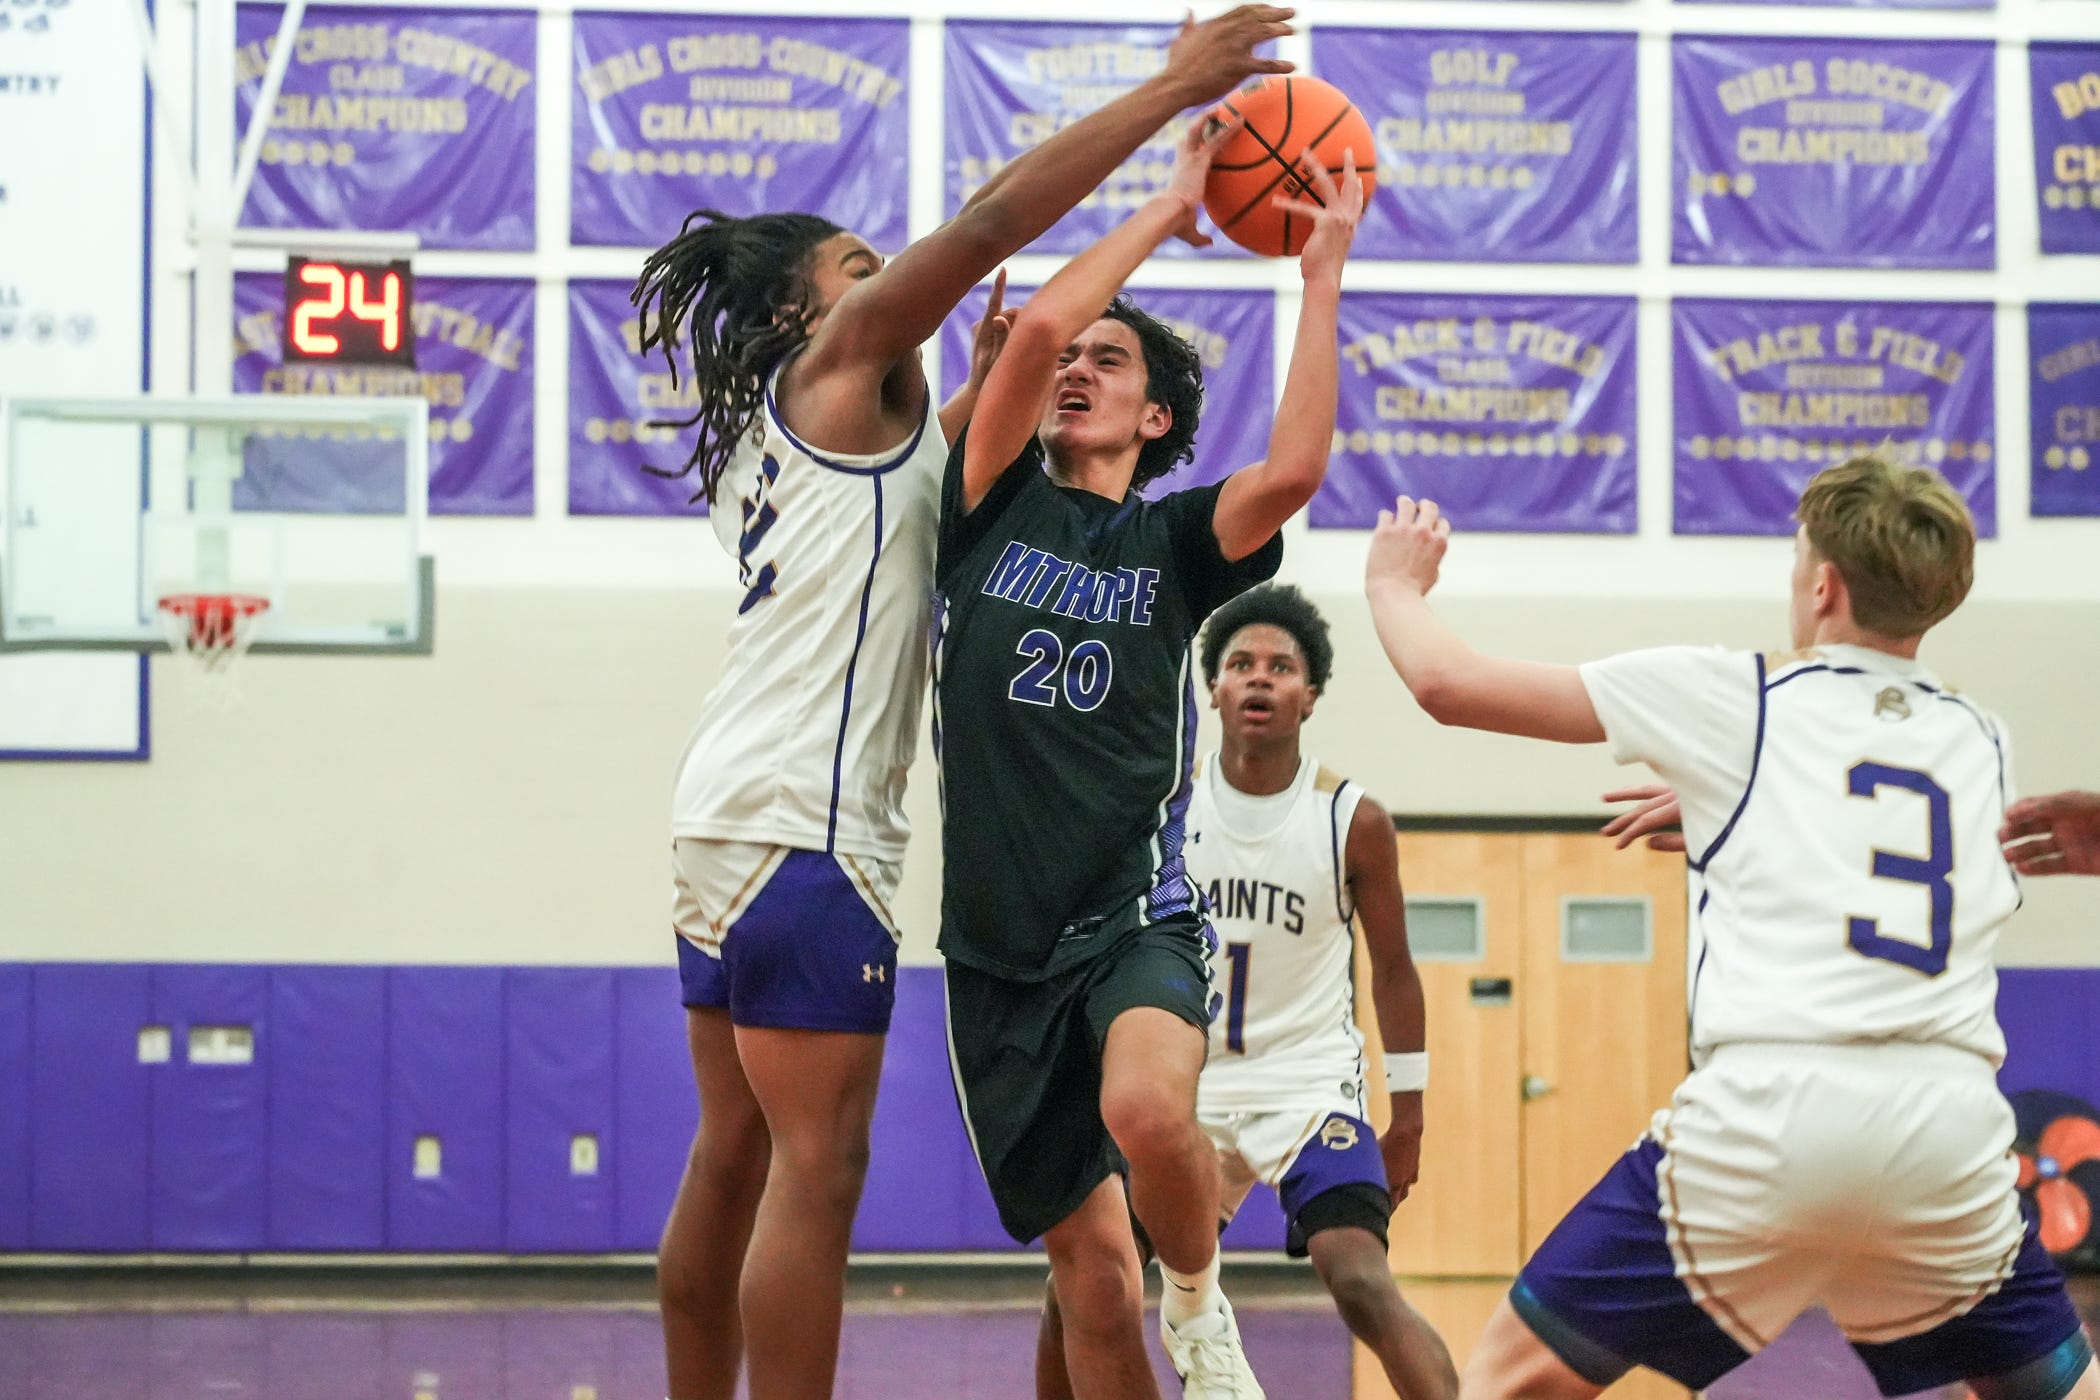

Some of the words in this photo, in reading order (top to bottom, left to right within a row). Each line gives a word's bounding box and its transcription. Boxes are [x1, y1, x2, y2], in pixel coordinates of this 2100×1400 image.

[579, 42, 664, 101] GIRLS
[1430, 49, 1520, 86] GOLF
[1717, 59, 1817, 115] GIRLS
[1826, 58, 1955, 118] SOCCER
[267, 95, 468, 133] CHAMPIONS
[639, 103, 842, 143] CHAMPIONS
[1377, 116, 1573, 155] CHAMPIONS
[1786, 100, 1885, 126] DIVISION
[1738, 127, 1930, 164] CHAMPIONS
[293, 263, 401, 355] 24
[1342, 318, 1461, 377] TRACK
[1507, 319, 1605, 379] FIELD
[1714, 324, 1824, 382] TRACK
[1868, 325, 1965, 385] FIELD
[1375, 386, 1571, 422] CHAMPIONS
[1738, 391, 1930, 427] CHAMPIONS
[1008, 628, 1113, 712] 20
[1845, 757, 1955, 971] 3
[1205, 877, 1306, 936] AINTS
